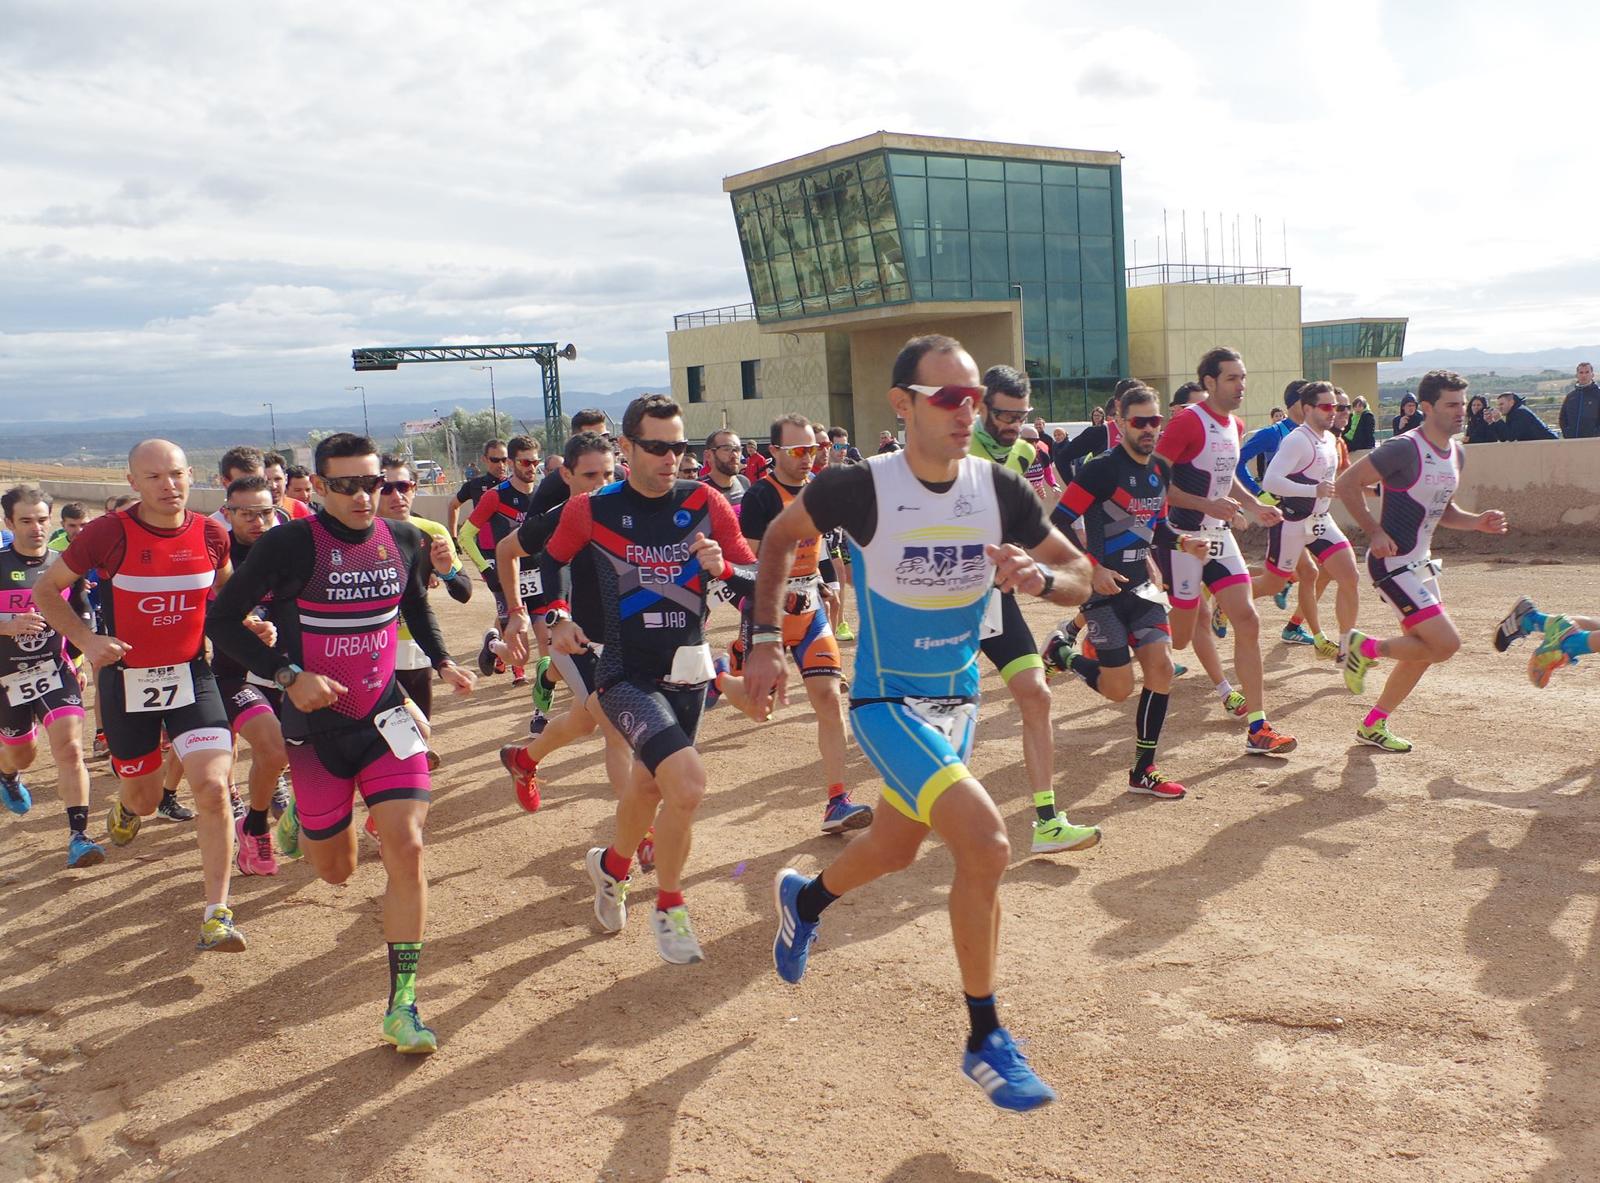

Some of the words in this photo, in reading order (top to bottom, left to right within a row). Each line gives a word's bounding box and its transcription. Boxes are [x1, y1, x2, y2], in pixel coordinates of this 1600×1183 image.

[1127, 496, 1163, 513] ALVAREZ
[1135, 513, 1152, 528] ESP
[625, 542, 690, 563] FRANCES
[328, 567, 398, 585] OCTAVUS
[638, 566, 683, 584] ESP
[326, 581, 401, 601] TRIATLÓN
[138, 594, 197, 614] GIL
[152, 614, 182, 626] ESP
[664, 611, 686, 628] JAB
[324, 630, 388, 658] URBANO
[19, 677, 51, 701] 56
[143, 684, 179, 708] 27
